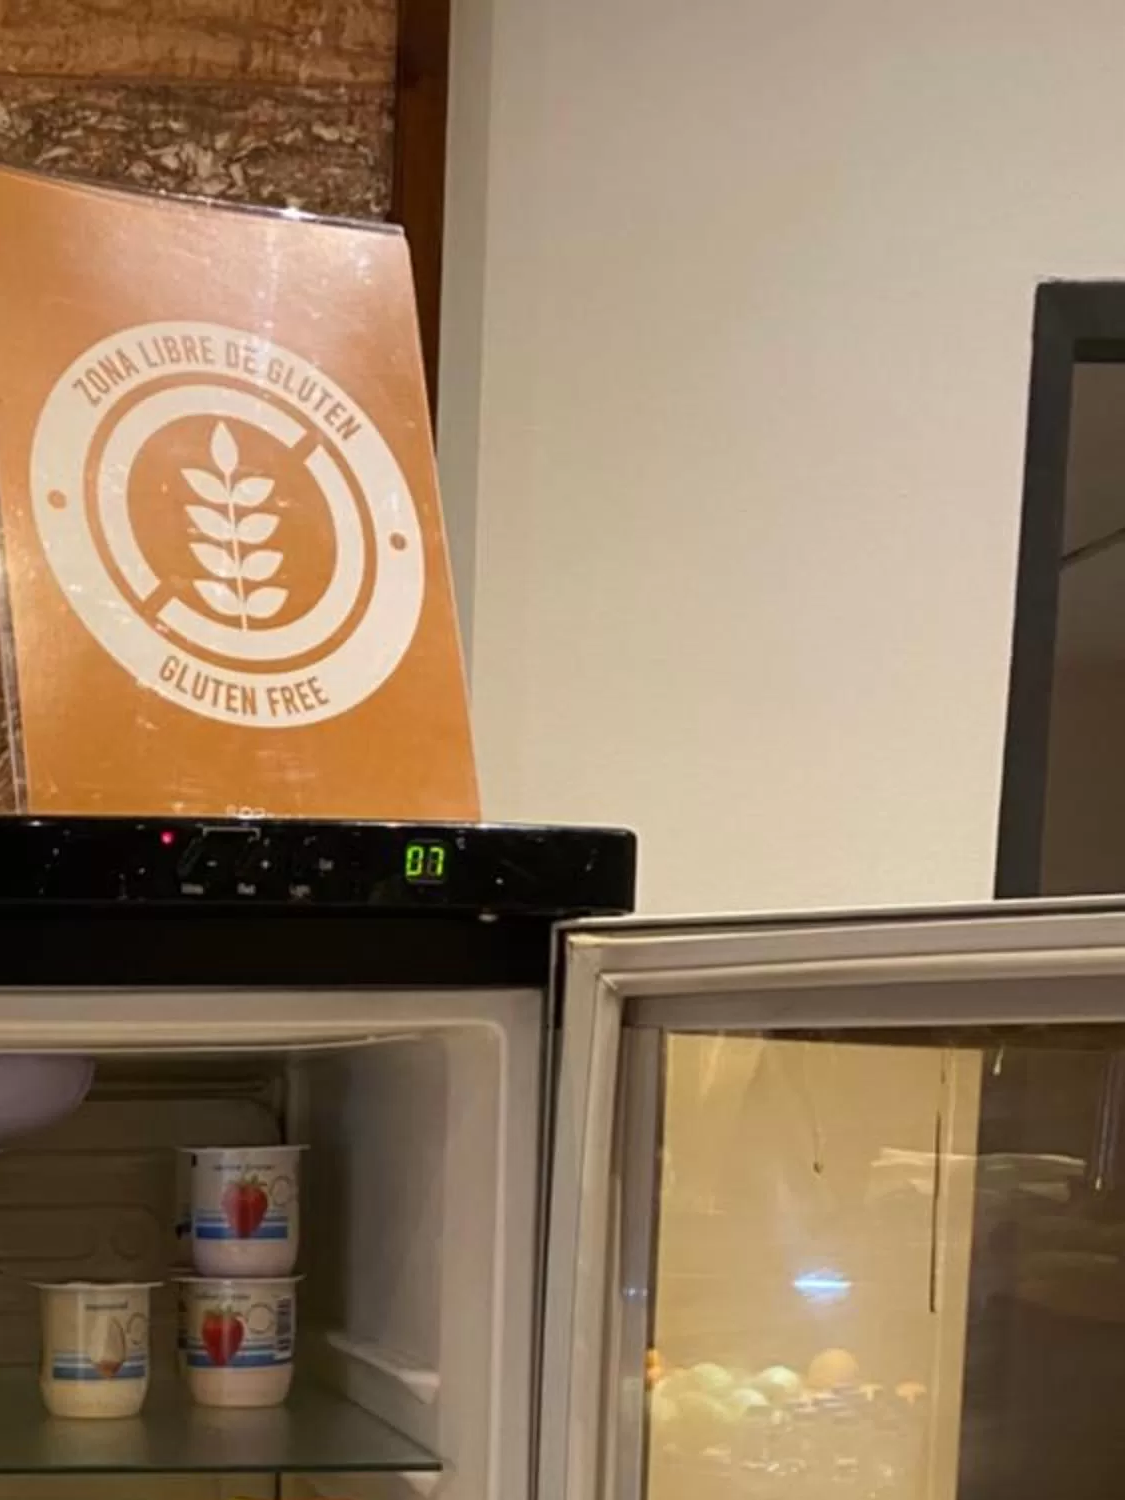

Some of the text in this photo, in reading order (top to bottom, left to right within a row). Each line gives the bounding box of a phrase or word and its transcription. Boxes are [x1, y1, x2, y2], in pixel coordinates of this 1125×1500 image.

[72, 335, 362, 442] ZONA LIBRE DE GLUTEN
[159, 654, 331, 717] GLUTEN FREE
[406, 846, 444, 876] 07
